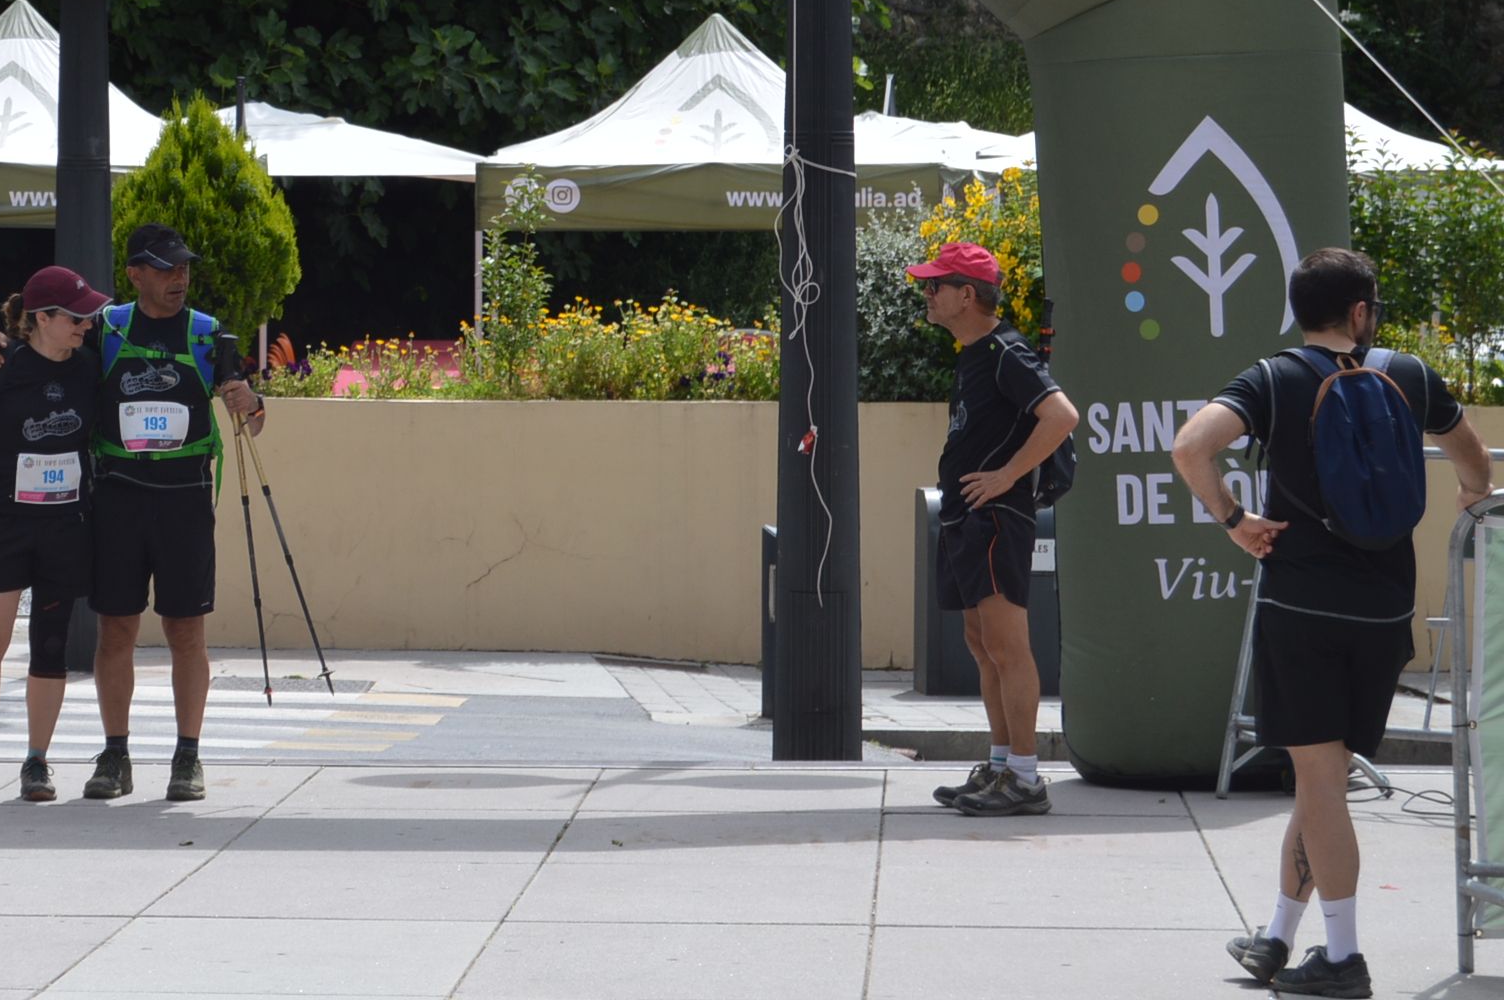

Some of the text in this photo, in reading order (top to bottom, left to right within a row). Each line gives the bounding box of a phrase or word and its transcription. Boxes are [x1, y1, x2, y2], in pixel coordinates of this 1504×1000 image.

[143, 416, 168, 431] 193
[43, 469, 65, 484] 194
[1116, 473, 1175, 525] DE
[1154, 557, 1254, 600] Viu-
